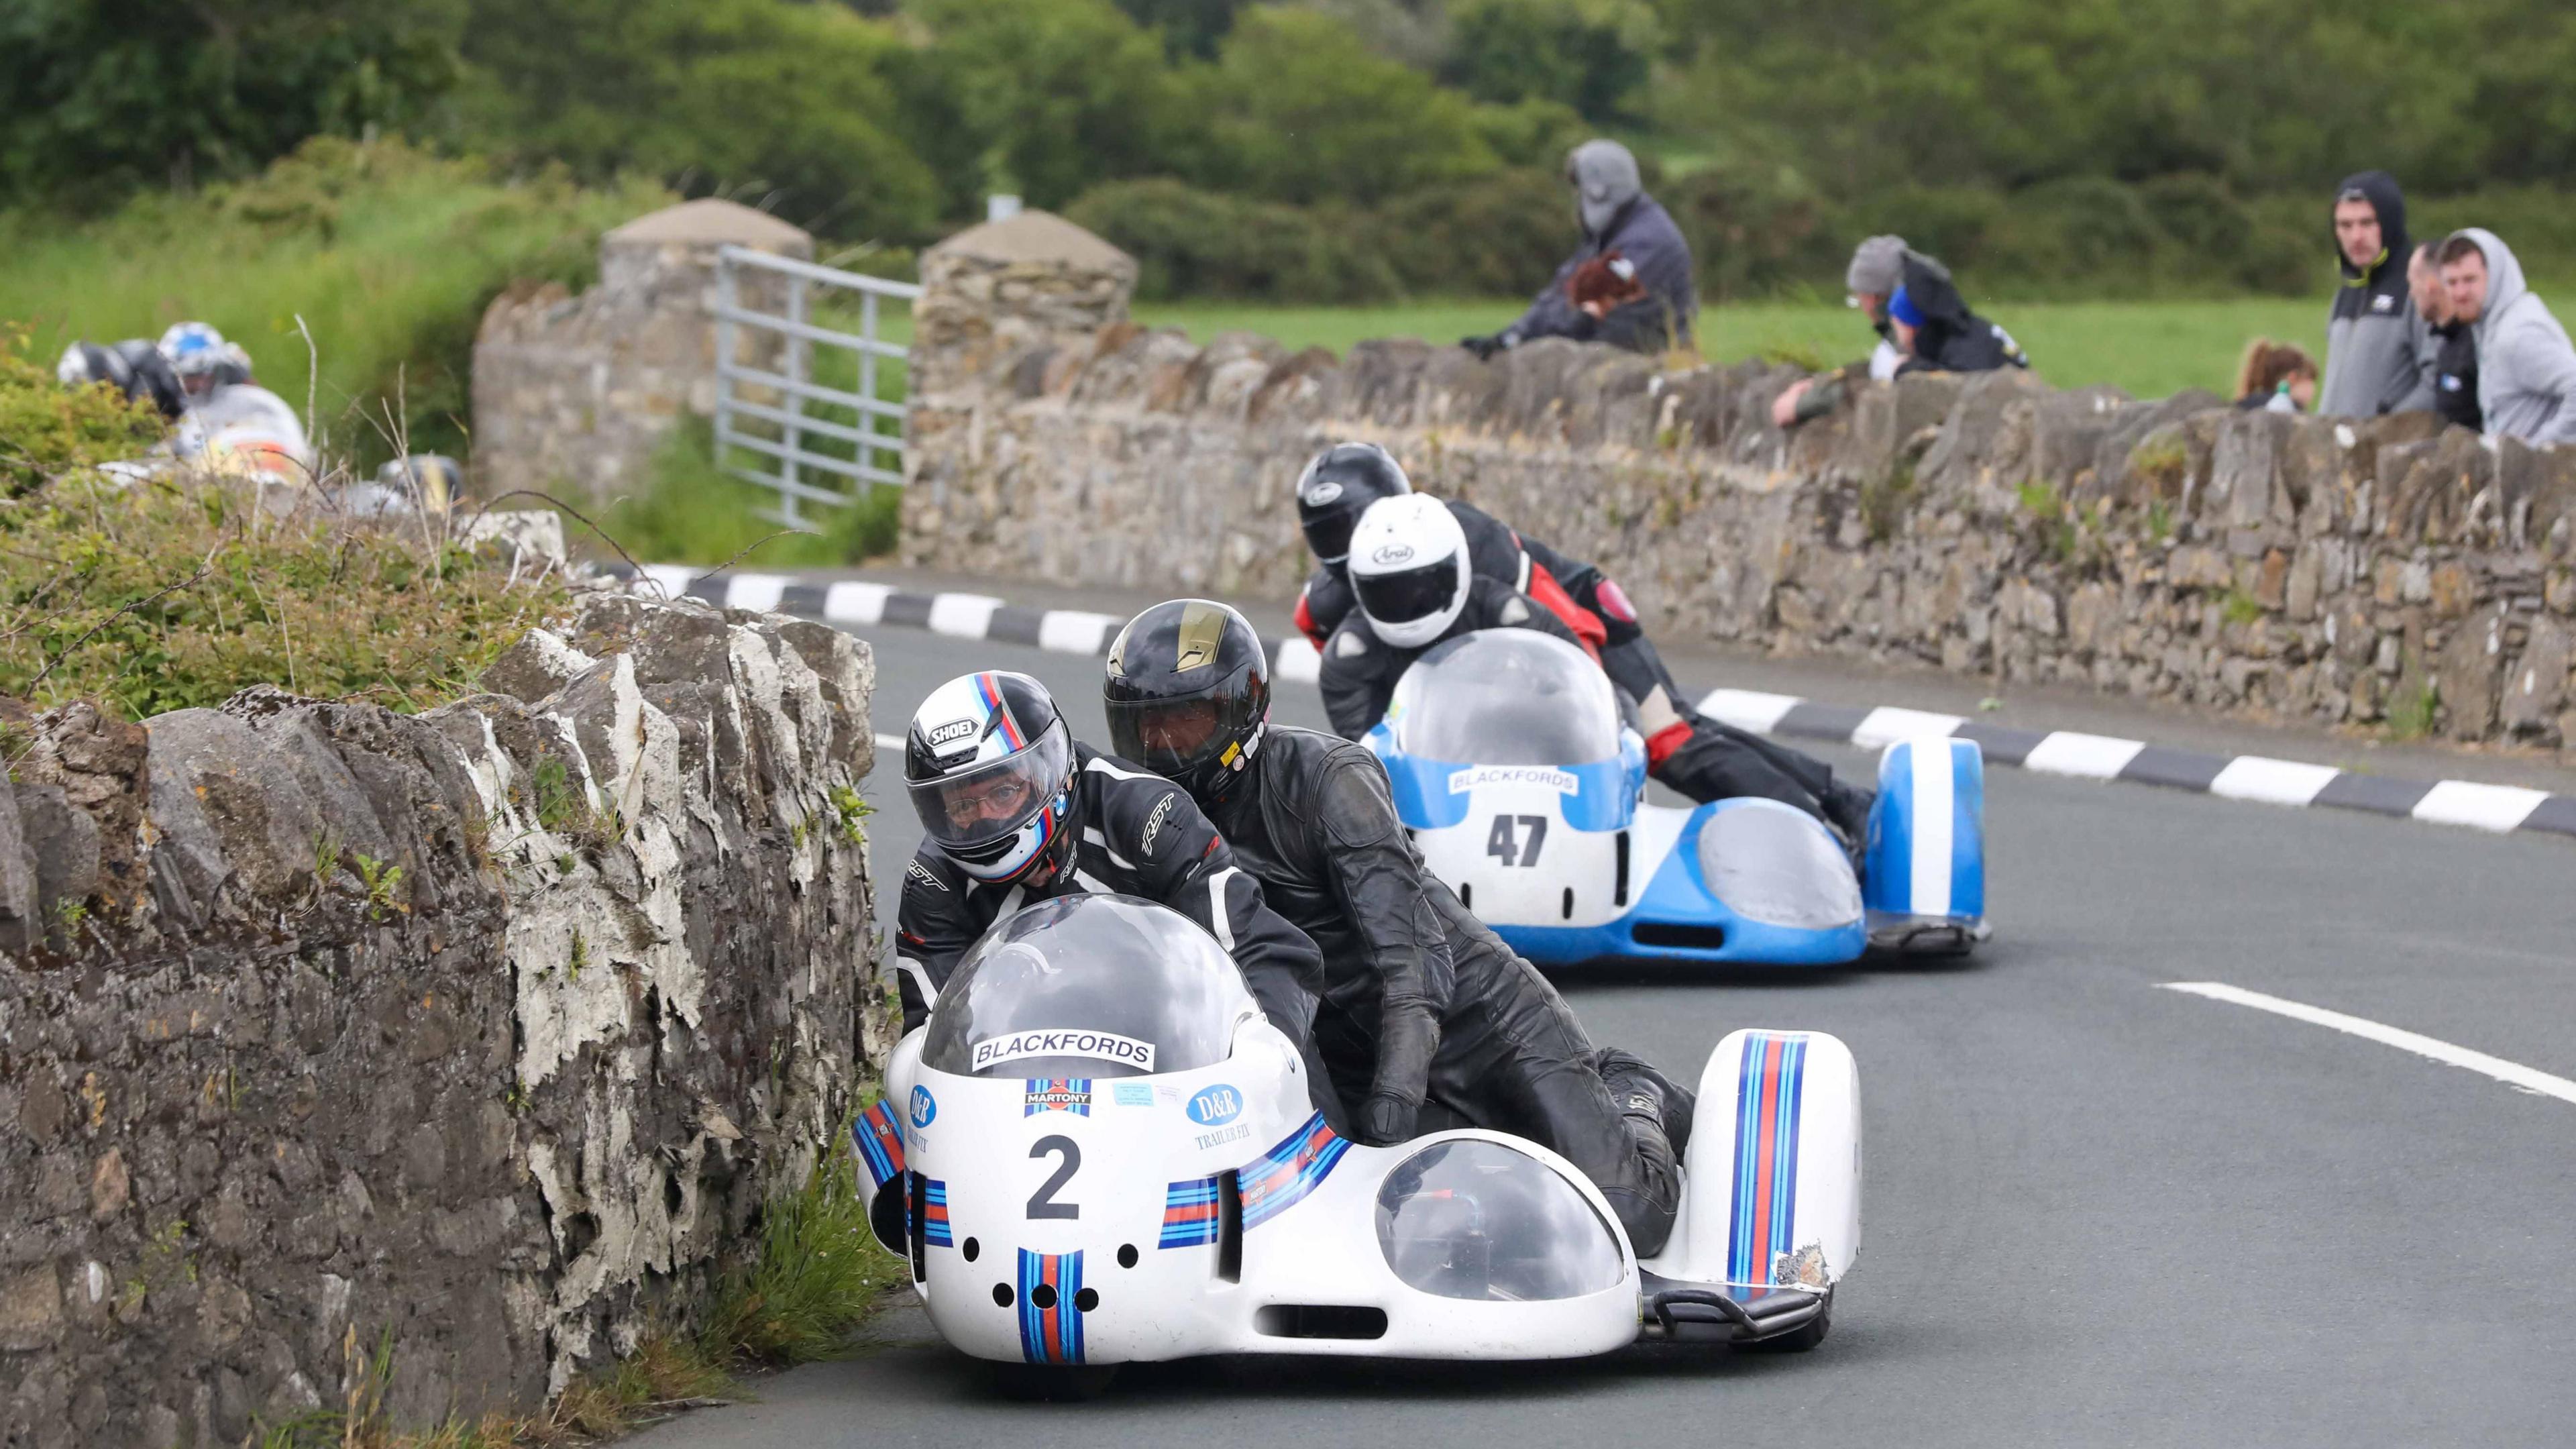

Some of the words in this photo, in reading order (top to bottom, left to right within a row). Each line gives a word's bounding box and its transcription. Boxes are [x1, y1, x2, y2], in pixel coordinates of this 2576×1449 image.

[931, 720, 973, 745] SHOEI
[1454, 769, 1574, 790] BLACKFORDS
[1142, 792, 1175, 857] RST
[1487, 814, 1548, 867] 47
[1060, 840, 1077, 884] RST
[977, 1034, 1149, 1063] BLACKFORDS
[911, 1089, 930, 1124] D&R
[1027, 1093, 1089, 1103] MARTONY
[1195, 1089, 1238, 1122] D&R
[1195, 1127, 1237, 1150] TRAILER
[1236, 1123, 1250, 1140] FIX
[1026, 1134, 1081, 1220] 2
